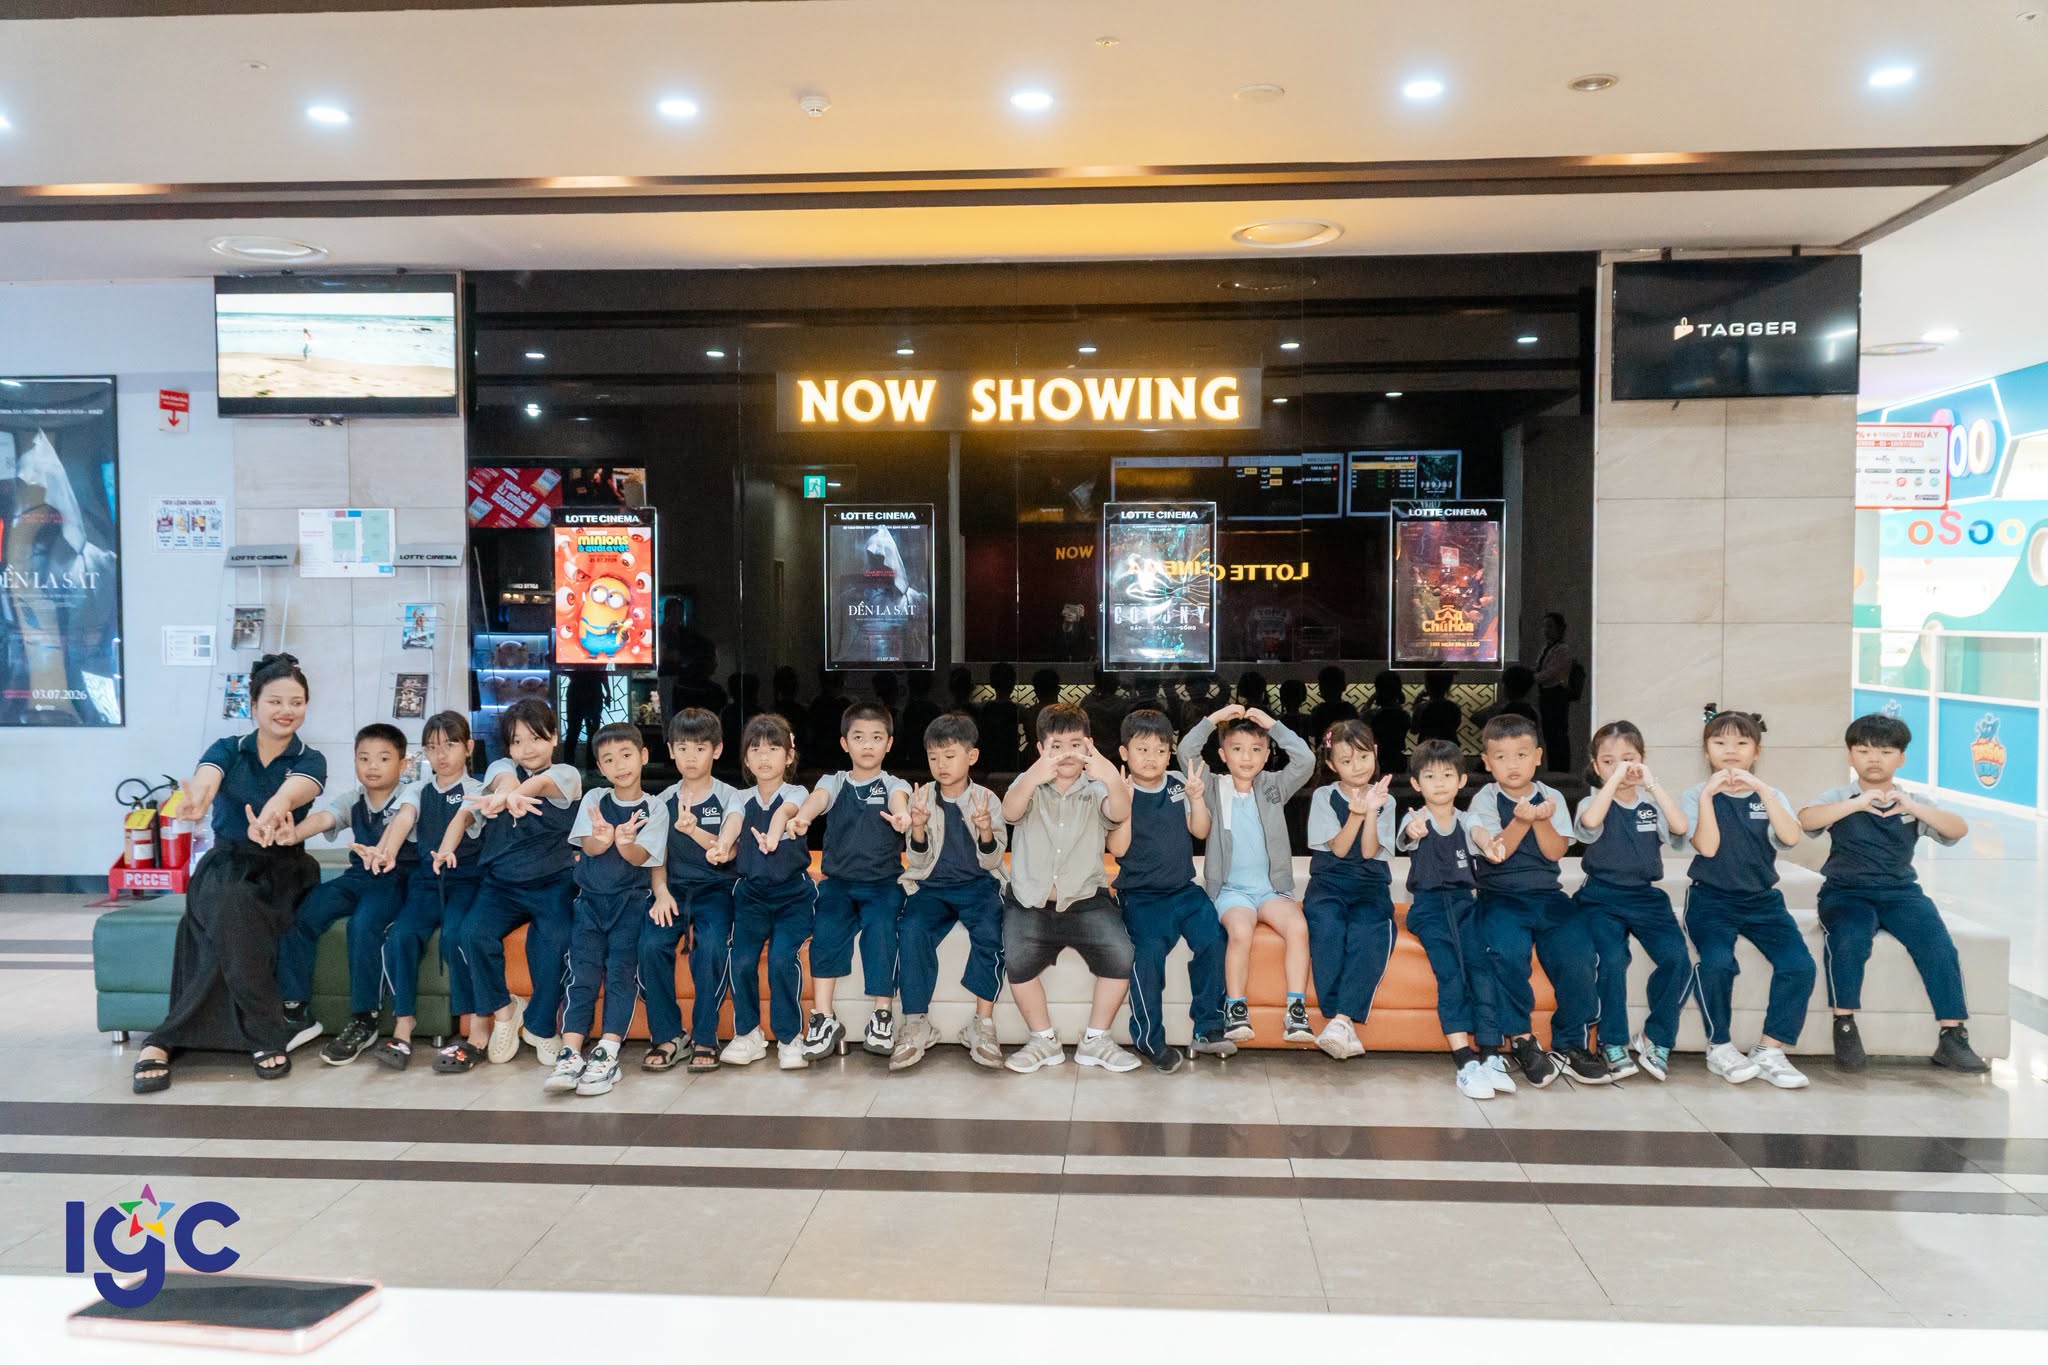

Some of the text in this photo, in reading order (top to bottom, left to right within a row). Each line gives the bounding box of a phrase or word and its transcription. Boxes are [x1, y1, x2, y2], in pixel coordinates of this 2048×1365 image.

[1697, 321, 1797, 337] TAGGER
[797, 376, 1241, 423] NOW SHOWING
[565, 515, 640, 523] LOTTE CINEMA
[840, 512, 917, 520] LOTTE CINEMA
[1121, 511, 1199, 519] LOTTE CINEMA
[1408, 508, 1488, 517] LOTTE CINEMA
[1055, 545, 1094, 561] NOW
[849, 600, 875, 616] ĐỀN
[876, 605, 893, 616] LA
[31, 688, 88, 700] 03.07.2026
[126, 872, 160, 886] PCCC
